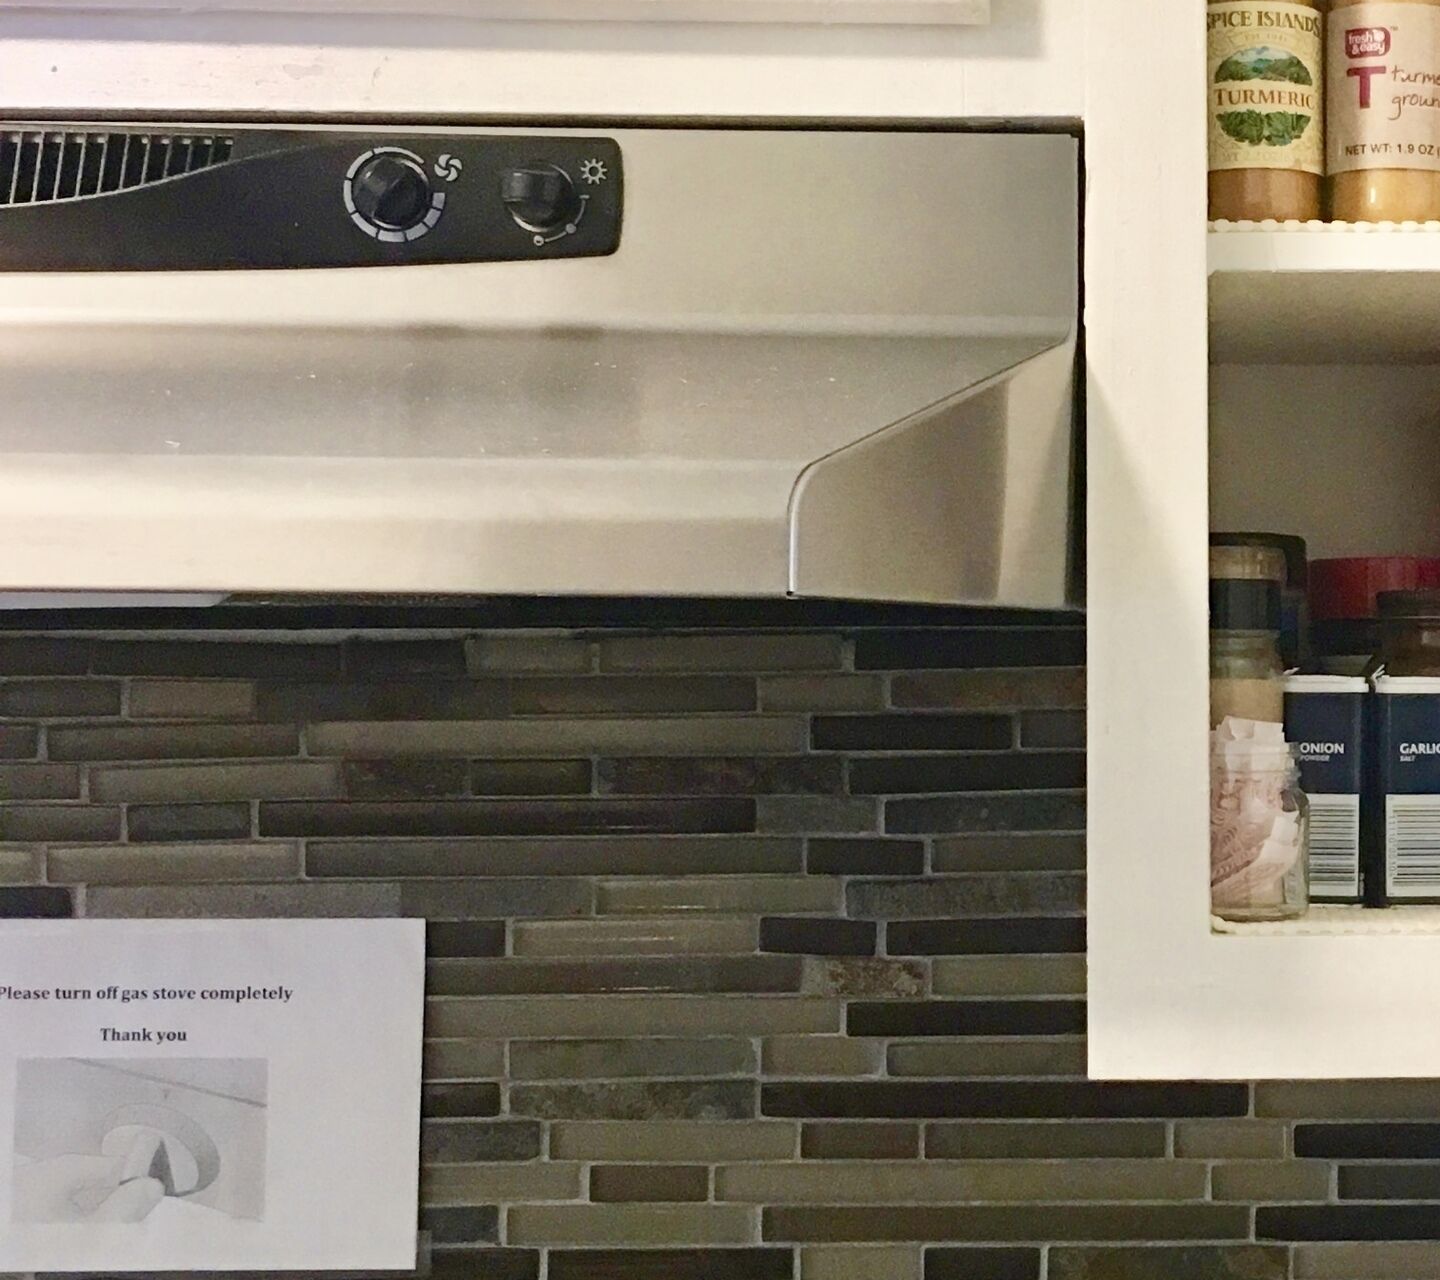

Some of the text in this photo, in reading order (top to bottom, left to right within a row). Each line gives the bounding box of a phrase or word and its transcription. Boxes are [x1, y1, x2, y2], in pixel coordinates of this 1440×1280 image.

[1257, 11, 1321, 39] ISLANDS
[1349, 31, 1372, 44] fresh
[1352, 42, 1385, 55] & easy
[1346, 66, 1386, 109] T
[1215, 88, 1316, 110] TURMERIC
[1345, 144, 1366, 156] NET
[1397, 143, 1414, 153] 1.9
[1418, 144, 1434, 155] OZ
[1300, 742, 1344, 754] ONION
[0, 985, 294, 1004] Please turn off gas stove completely
[100, 1027, 188, 1045] Thank you
